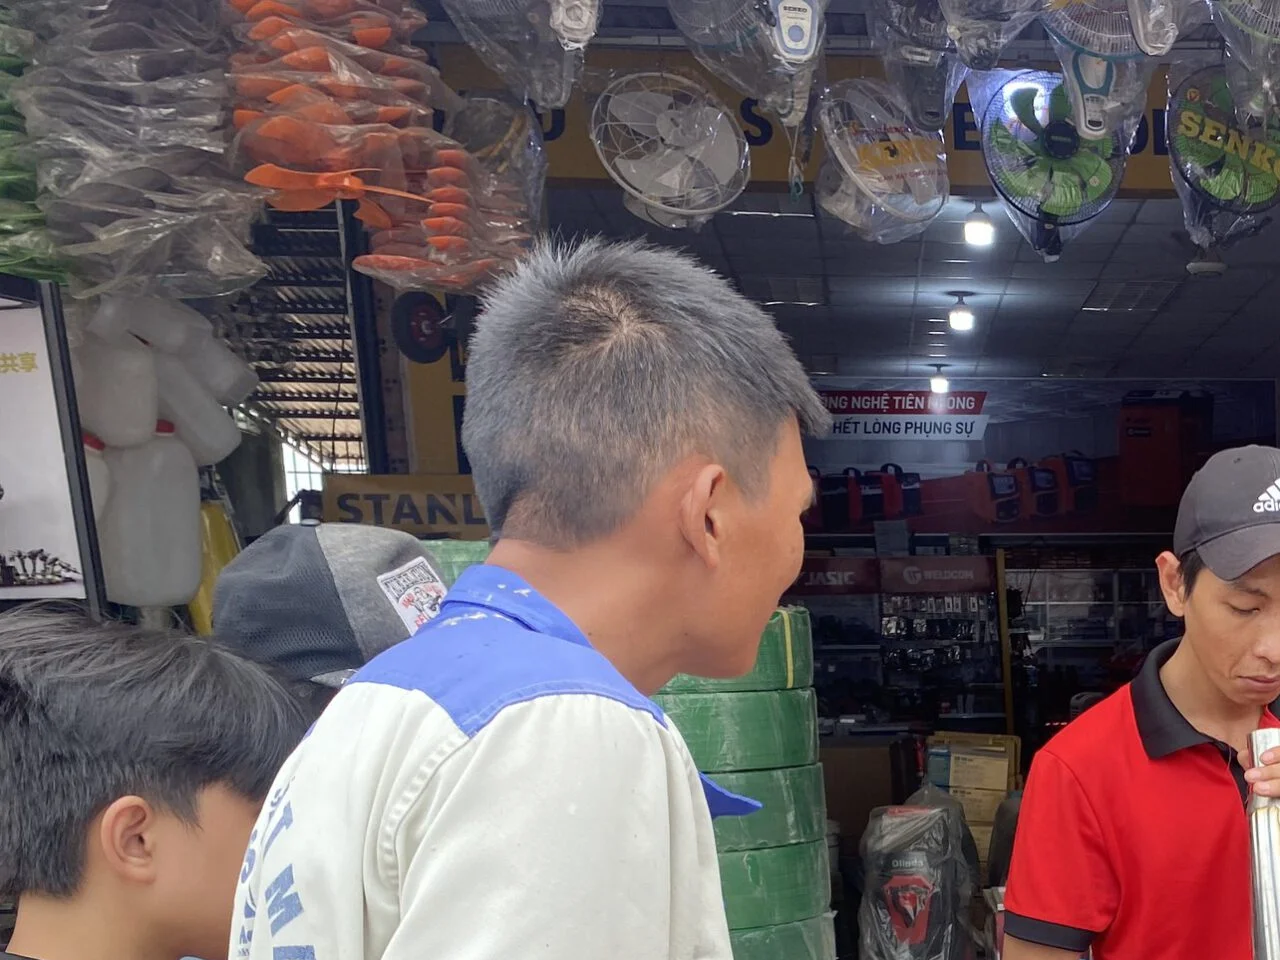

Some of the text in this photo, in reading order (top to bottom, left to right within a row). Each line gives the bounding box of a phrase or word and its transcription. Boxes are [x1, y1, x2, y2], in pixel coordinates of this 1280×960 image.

[851, 394, 889, 412] NGHỆ
[833, 417, 975, 437] HẾT LÒNG PHỤNG SỰ
[336, 491, 489, 526] STANL
